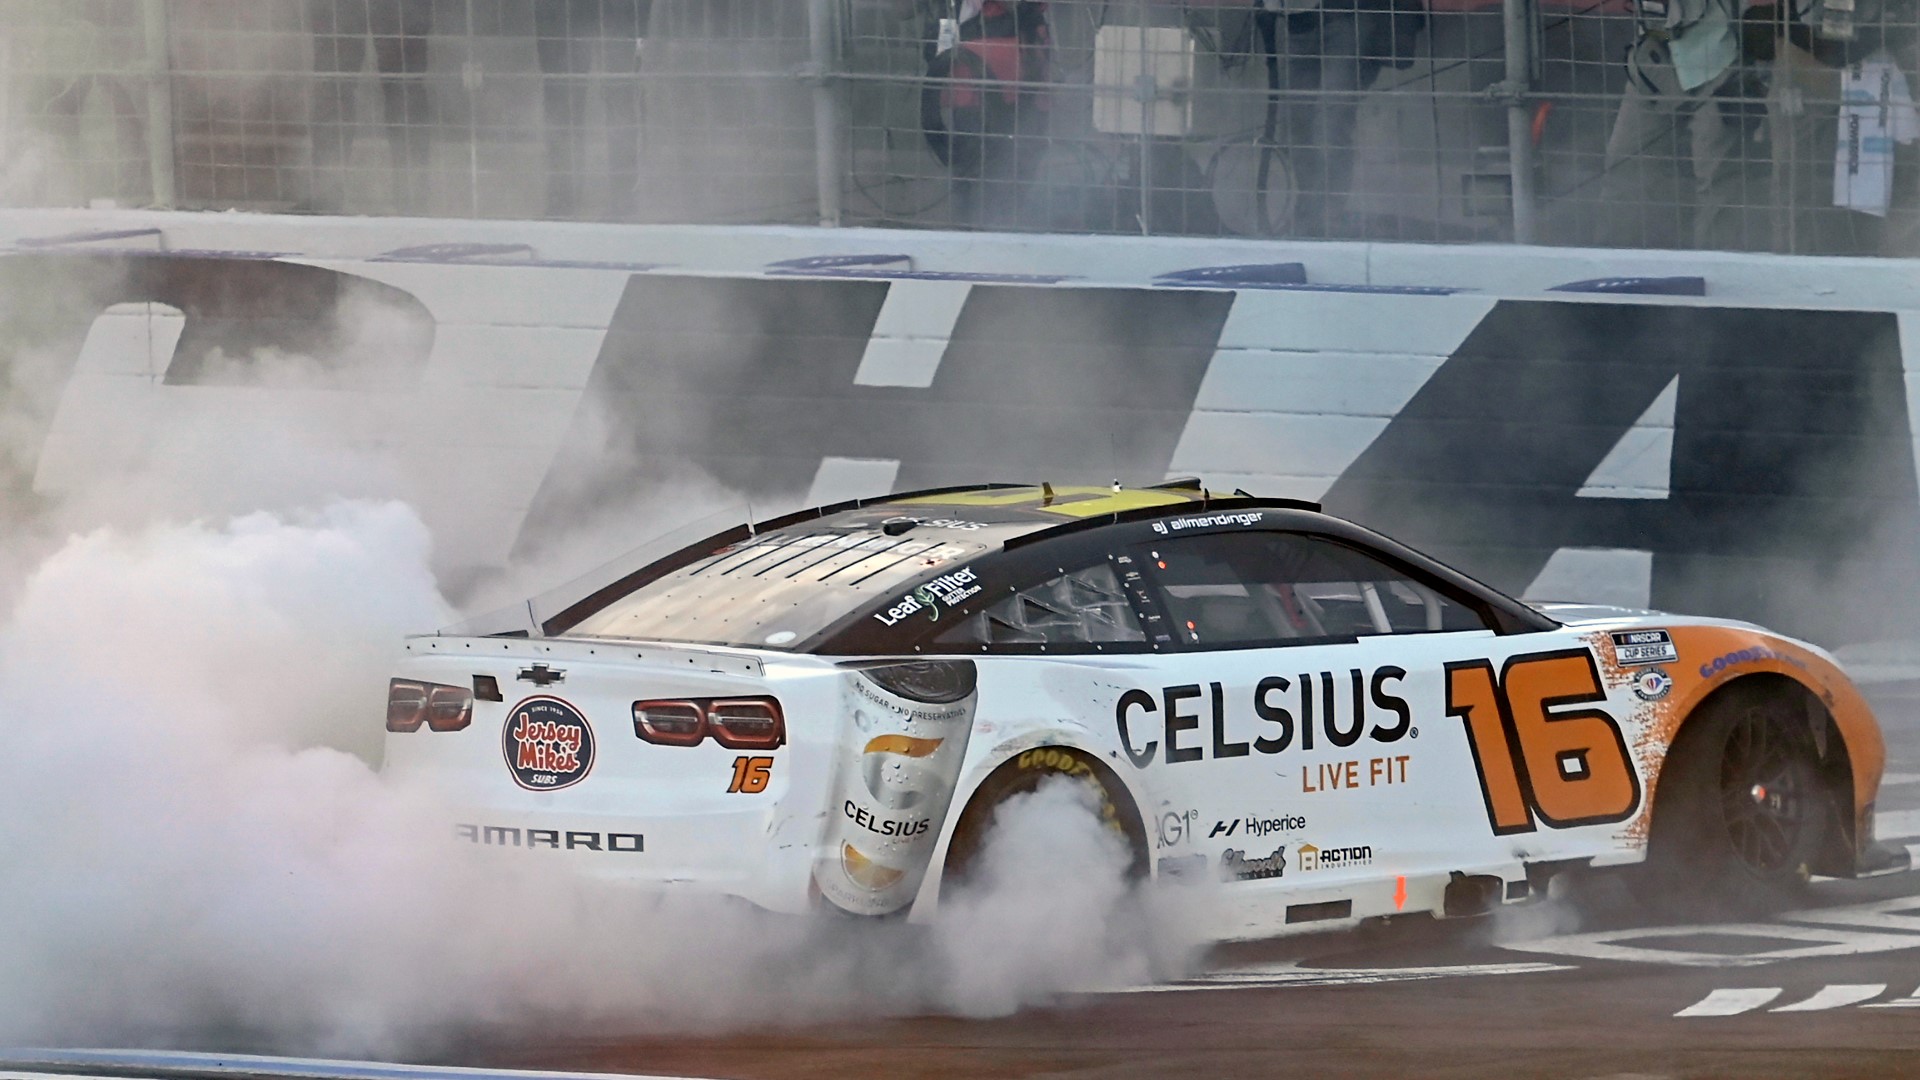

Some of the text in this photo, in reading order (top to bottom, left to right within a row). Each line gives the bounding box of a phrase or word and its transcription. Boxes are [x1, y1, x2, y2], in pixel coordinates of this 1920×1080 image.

[1152, 513, 1263, 534] aj allmendinger
[873, 566, 977, 626] Leaf Filter
[946, 585, 982, 606] PROTECTION
[1624, 646, 1667, 658] CUP SERIES
[1630, 633, 1662, 643] NASCAR
[855, 681, 866, 692] NO
[865, 689, 889, 709] SUGAR
[897, 706, 909, 716] NO
[514, 713, 581, 752] Jersey
[1115, 665, 1411, 769] CELSIUS
[517, 740, 580, 773] Mike's
[1443, 646, 1642, 837] 16
[530, 774, 558, 785] SUBS
[727, 756, 774, 793] 16
[1303, 755, 1410, 793] LIVE FIT
[844, 800, 930, 836] CELSIUS
[1246, 814, 1306, 837] Hyperice
[455, 823, 644, 852] AMARO
[1320, 846, 1372, 863] ACTION
[1321, 860, 1372, 870] INDUSTRIES
